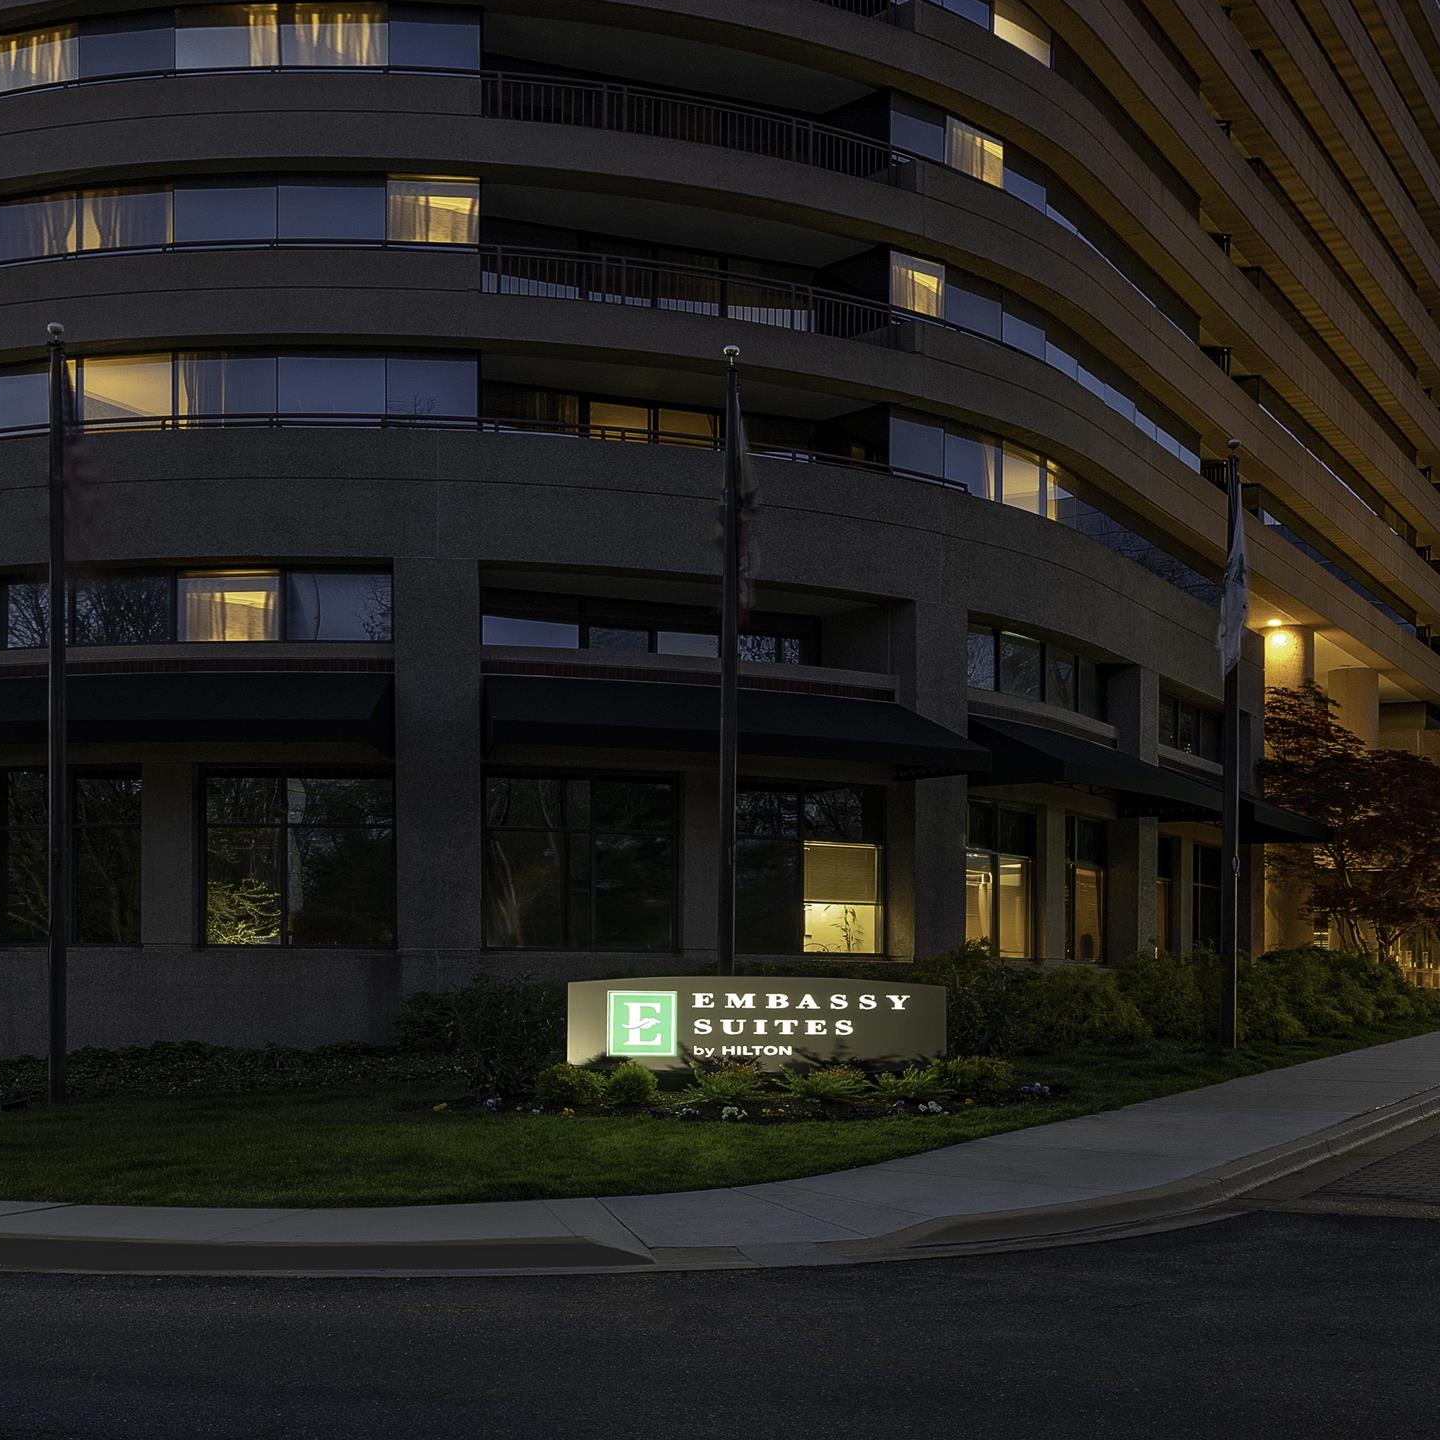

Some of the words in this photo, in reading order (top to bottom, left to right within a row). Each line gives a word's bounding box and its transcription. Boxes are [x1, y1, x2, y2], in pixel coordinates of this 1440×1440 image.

[691, 992, 911, 1010] EMBASSY
[621, 1002, 662, 1046] E
[693, 1018, 854, 1036] SUITES
[693, 1045, 715, 1058] by
[721, 1045, 793, 1056] HILTON
